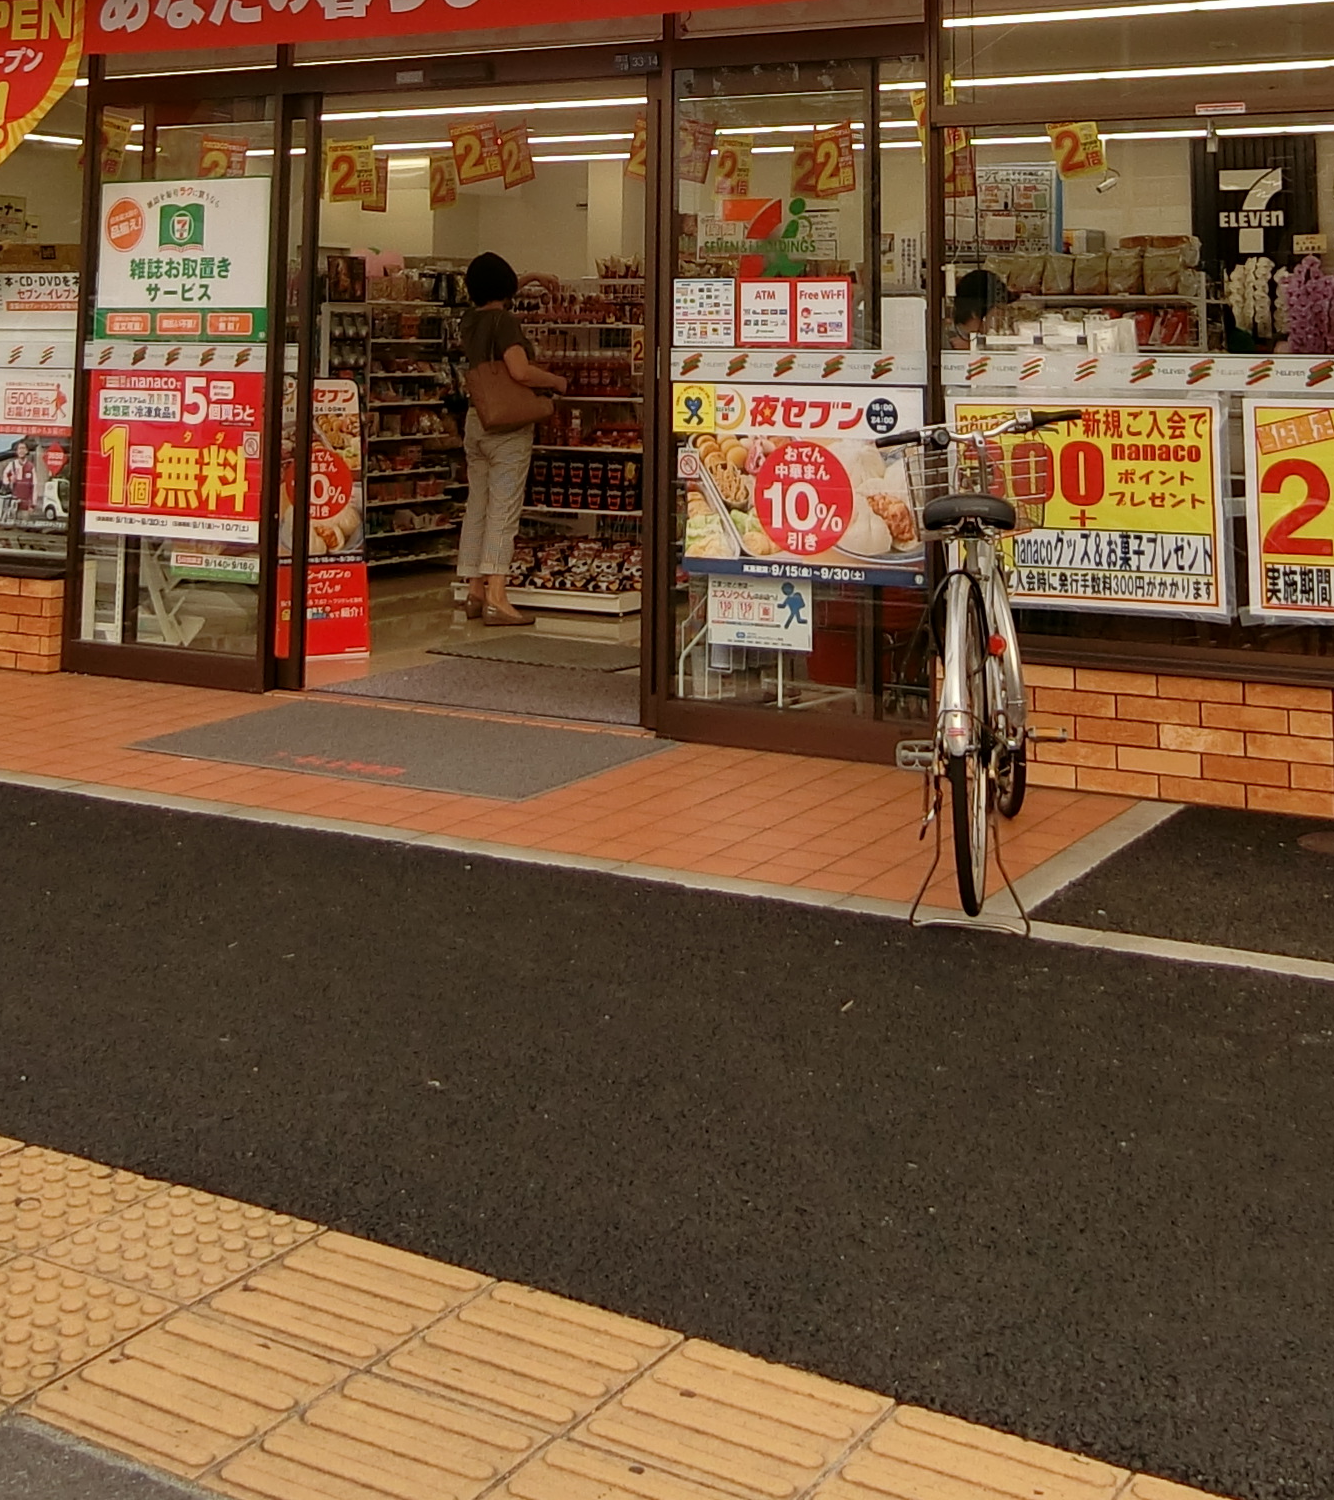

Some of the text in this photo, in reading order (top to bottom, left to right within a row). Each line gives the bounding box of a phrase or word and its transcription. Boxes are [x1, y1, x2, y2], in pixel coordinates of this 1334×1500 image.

[1054, 129, 1086, 174] 2
[129, 256, 232, 281] 雑誌お取置き
[145, 283, 212, 303] サービス
[754, 289, 776, 301] ATM
[799, 288, 846, 301] Free Wi-Fi
[750, 394, 864, 430] 夜セブン
[784, 446, 825, 463] おでん
[1111, 443, 1201, 463] nanaco
[774, 463, 830, 481] 中華まん
[1117, 468, 1195, 486] ポイント
[762, 481, 843, 533] 10%
[1108, 491, 1206, 510] プレゼント
[787, 533, 819, 551] 引き
[1266, 565, 1332, 606] 実施期間
